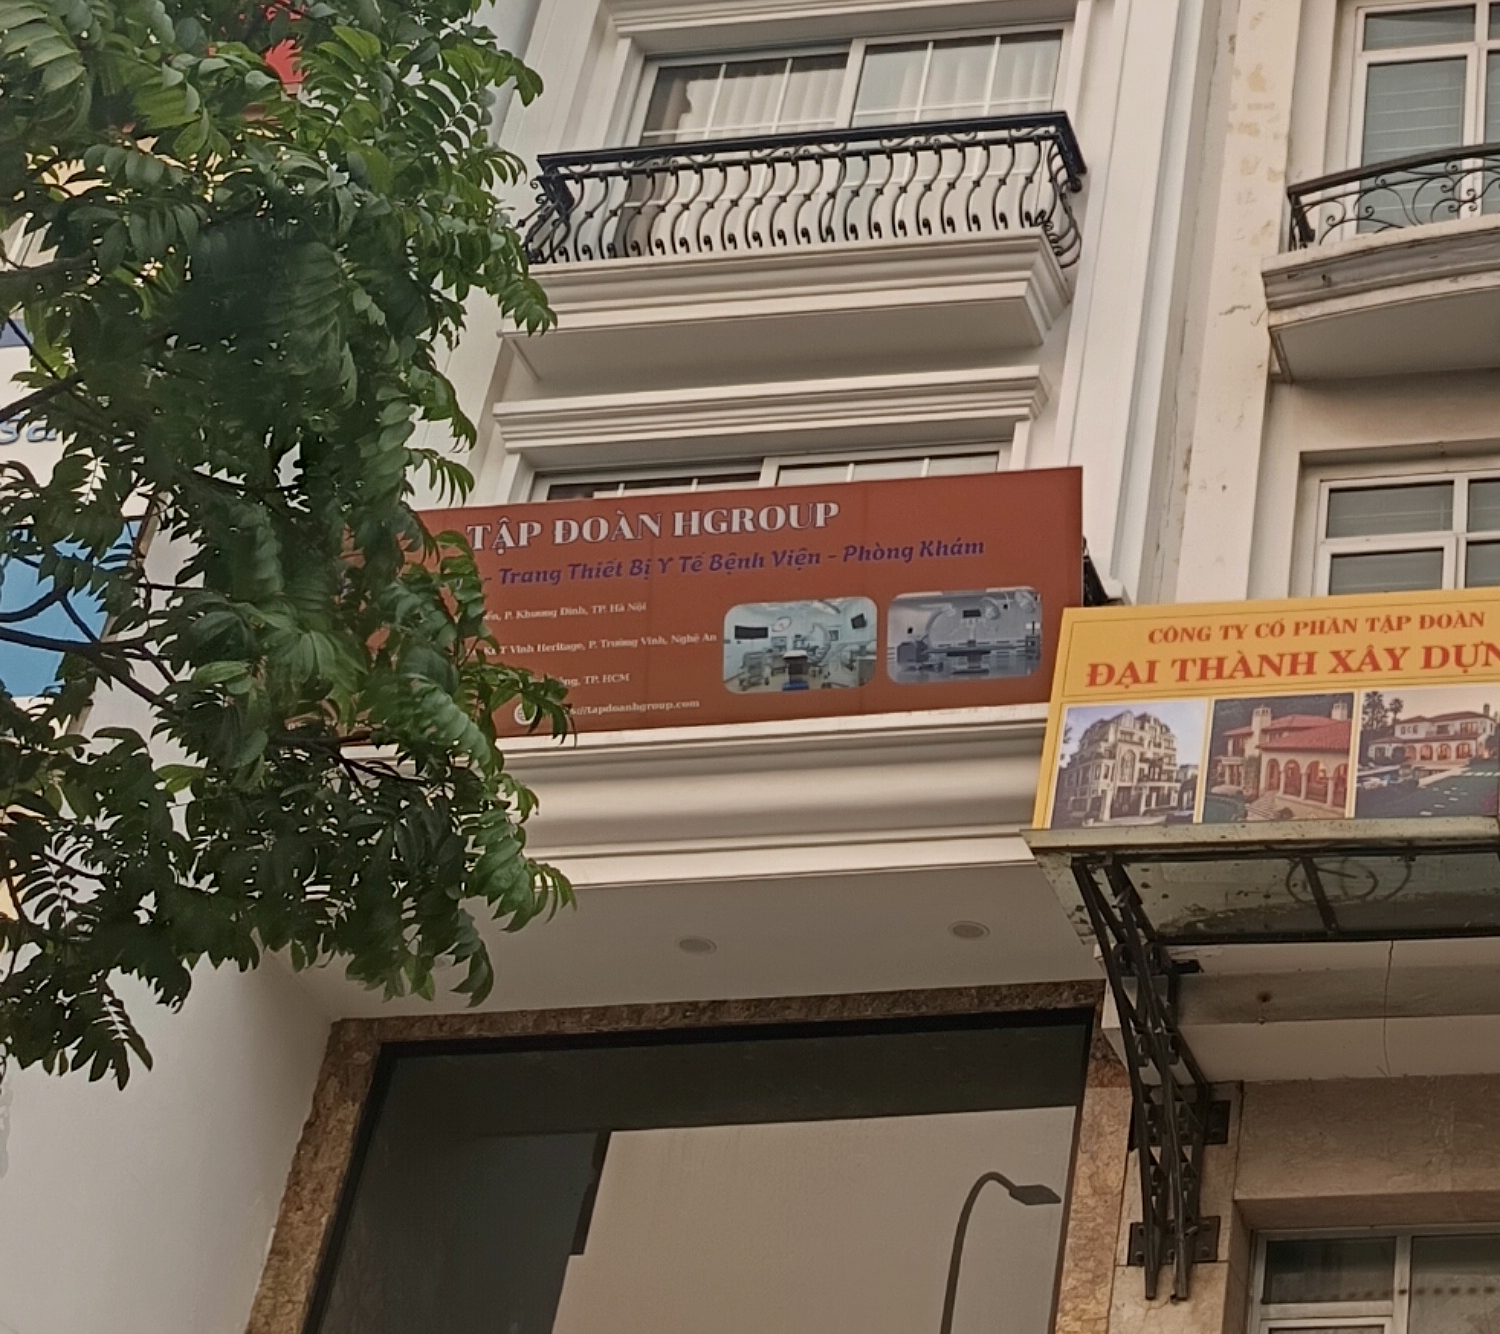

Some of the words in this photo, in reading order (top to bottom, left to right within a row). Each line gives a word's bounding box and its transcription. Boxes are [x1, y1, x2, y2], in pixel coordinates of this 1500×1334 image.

[466, 516, 543, 556] TẬP
[553, 509, 663, 546] ĐOÀN
[672, 501, 840, 538] HGROUP
[499, 567, 562, 586] Trang
[567, 558, 624, 581] Thiết
[629, 557, 652, 584] Bị
[658, 556, 674, 574] Y
[679, 551, 704, 573] Tế
[709, 551, 765, 576] Bệnh
[771, 547, 822, 573] Viện
[843, 541, 914, 564] Phòng
[919, 536, 986, 557] Khám
[1147, 621, 1212, 646] CÔNG
[1219, 622, 1249, 641] TY
[1255, 617, 1287, 640] CỔ
[1293, 615, 1358, 637] PHẦN
[1366, 612, 1413, 635] TẬP
[1418, 611, 1486, 631] ĐOÀN
[602, 673, 631, 684] HCM
[1085, 659, 1159, 690] ĐẠI
[1171, 648, 1320, 683] THÀNH
[1328, 643, 1412, 675] XÂY
